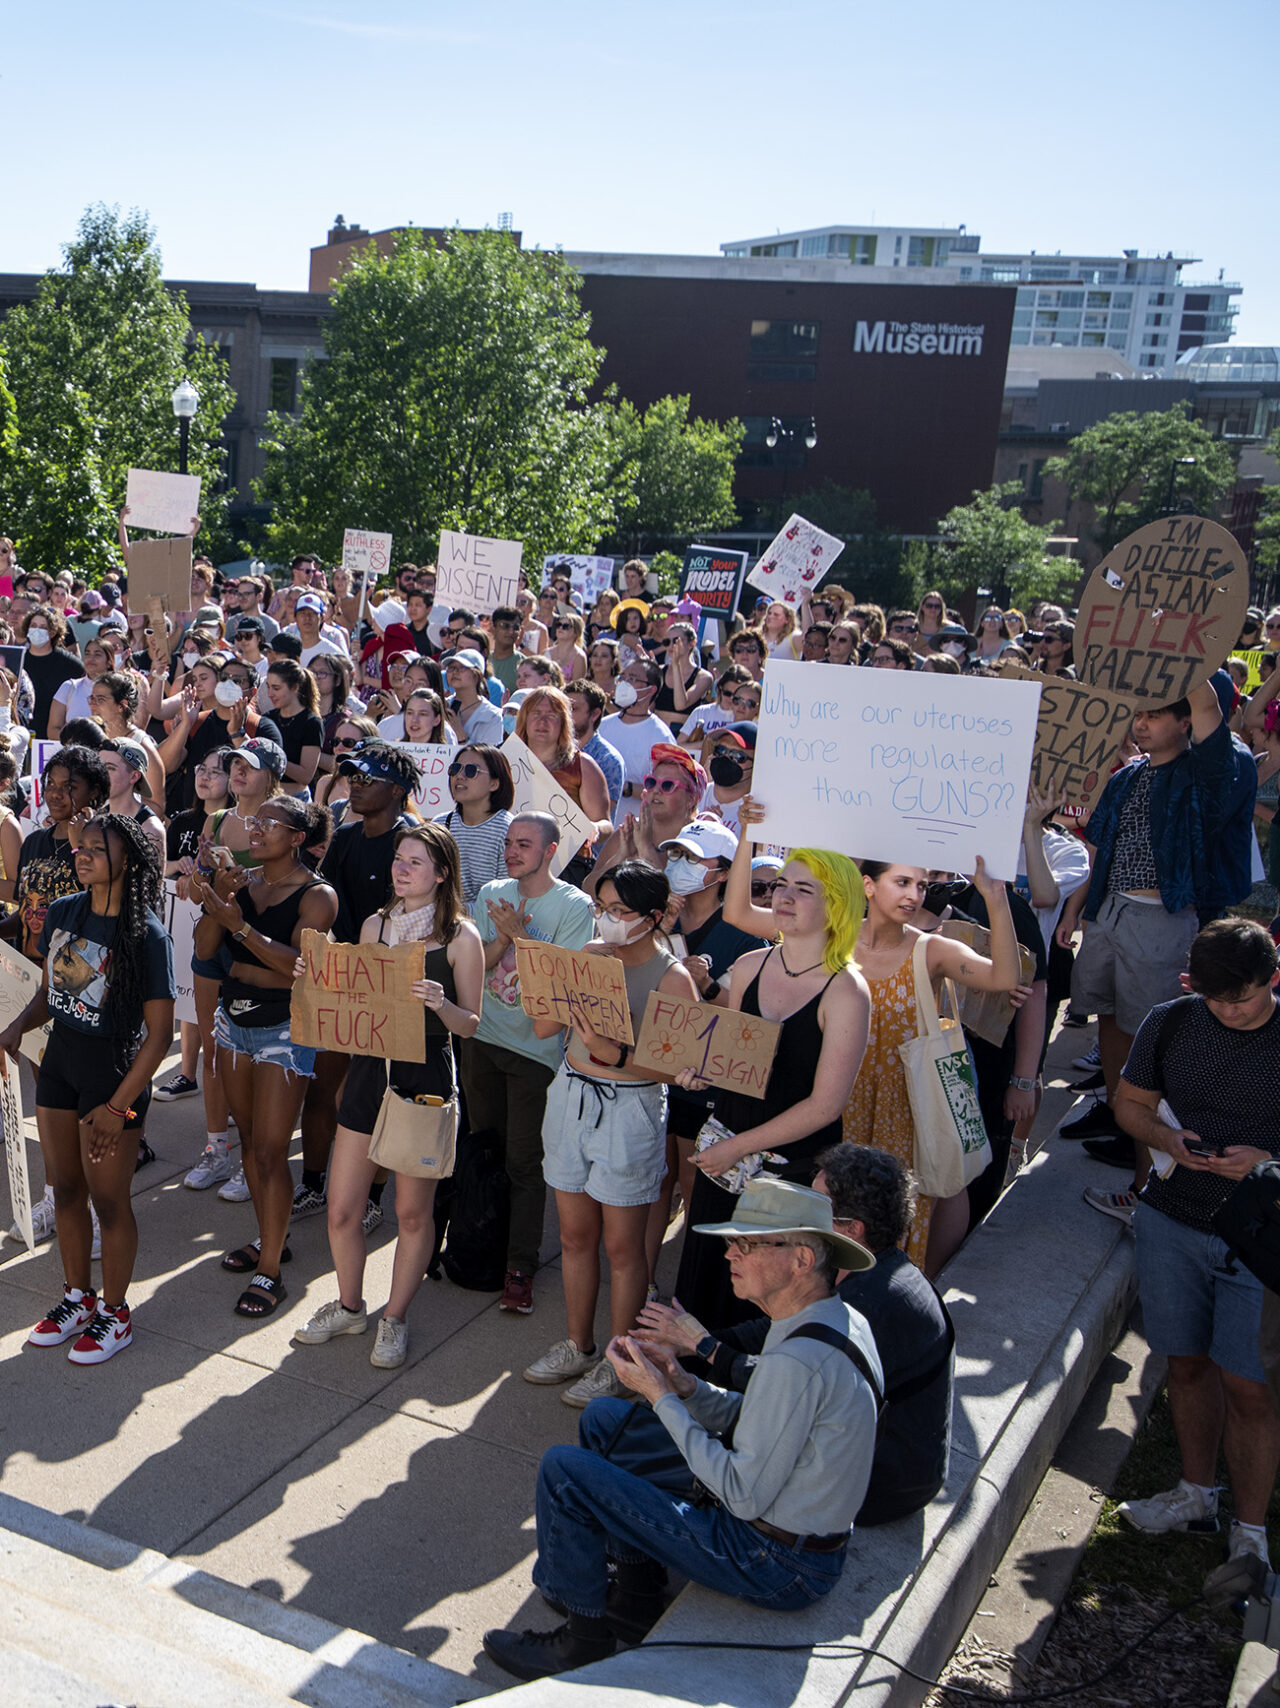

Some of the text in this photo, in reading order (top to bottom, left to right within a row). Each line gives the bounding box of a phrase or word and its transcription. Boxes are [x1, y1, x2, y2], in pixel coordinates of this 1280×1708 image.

[853, 320, 983, 355] Museum
[890, 321, 984, 335] The State Historical
[345, 536, 386, 550] RUTHLESS
[451, 536, 494, 568] WE
[1161, 519, 1205, 546] IM
[683, 571, 736, 592] MODEL
[689, 556, 738, 570] NOT your
[1123, 544, 1223, 580] DOCILE
[436, 565, 518, 606] DISSENT
[1120, 570, 1217, 615] ASIAN
[1082, 604, 1222, 655] FUCK
[1079, 644, 1205, 700] RACIST
[765, 683, 1013, 737] Why are our uteruses
[1039, 685, 1131, 735] STOP
[436, 747, 452, 757] feel
[775, 735, 1004, 781] more regulated
[812, 775, 1015, 818] than GUNS??
[1031, 752, 1099, 803] ATE!
[308, 949, 396, 994] WHAT
[517, 946, 623, 996] TOO MUCH
[232, 998, 253, 1010] NIKE
[332, 990, 369, 1005] THE
[523, 980, 626, 1026] IS HAPPEN
[317, 1008, 389, 1053] FUCK
[593, 1020, 628, 1041] -ING
[653, 999, 721, 1083] FOR 1
[708, 1054, 769, 1091] SIGN
